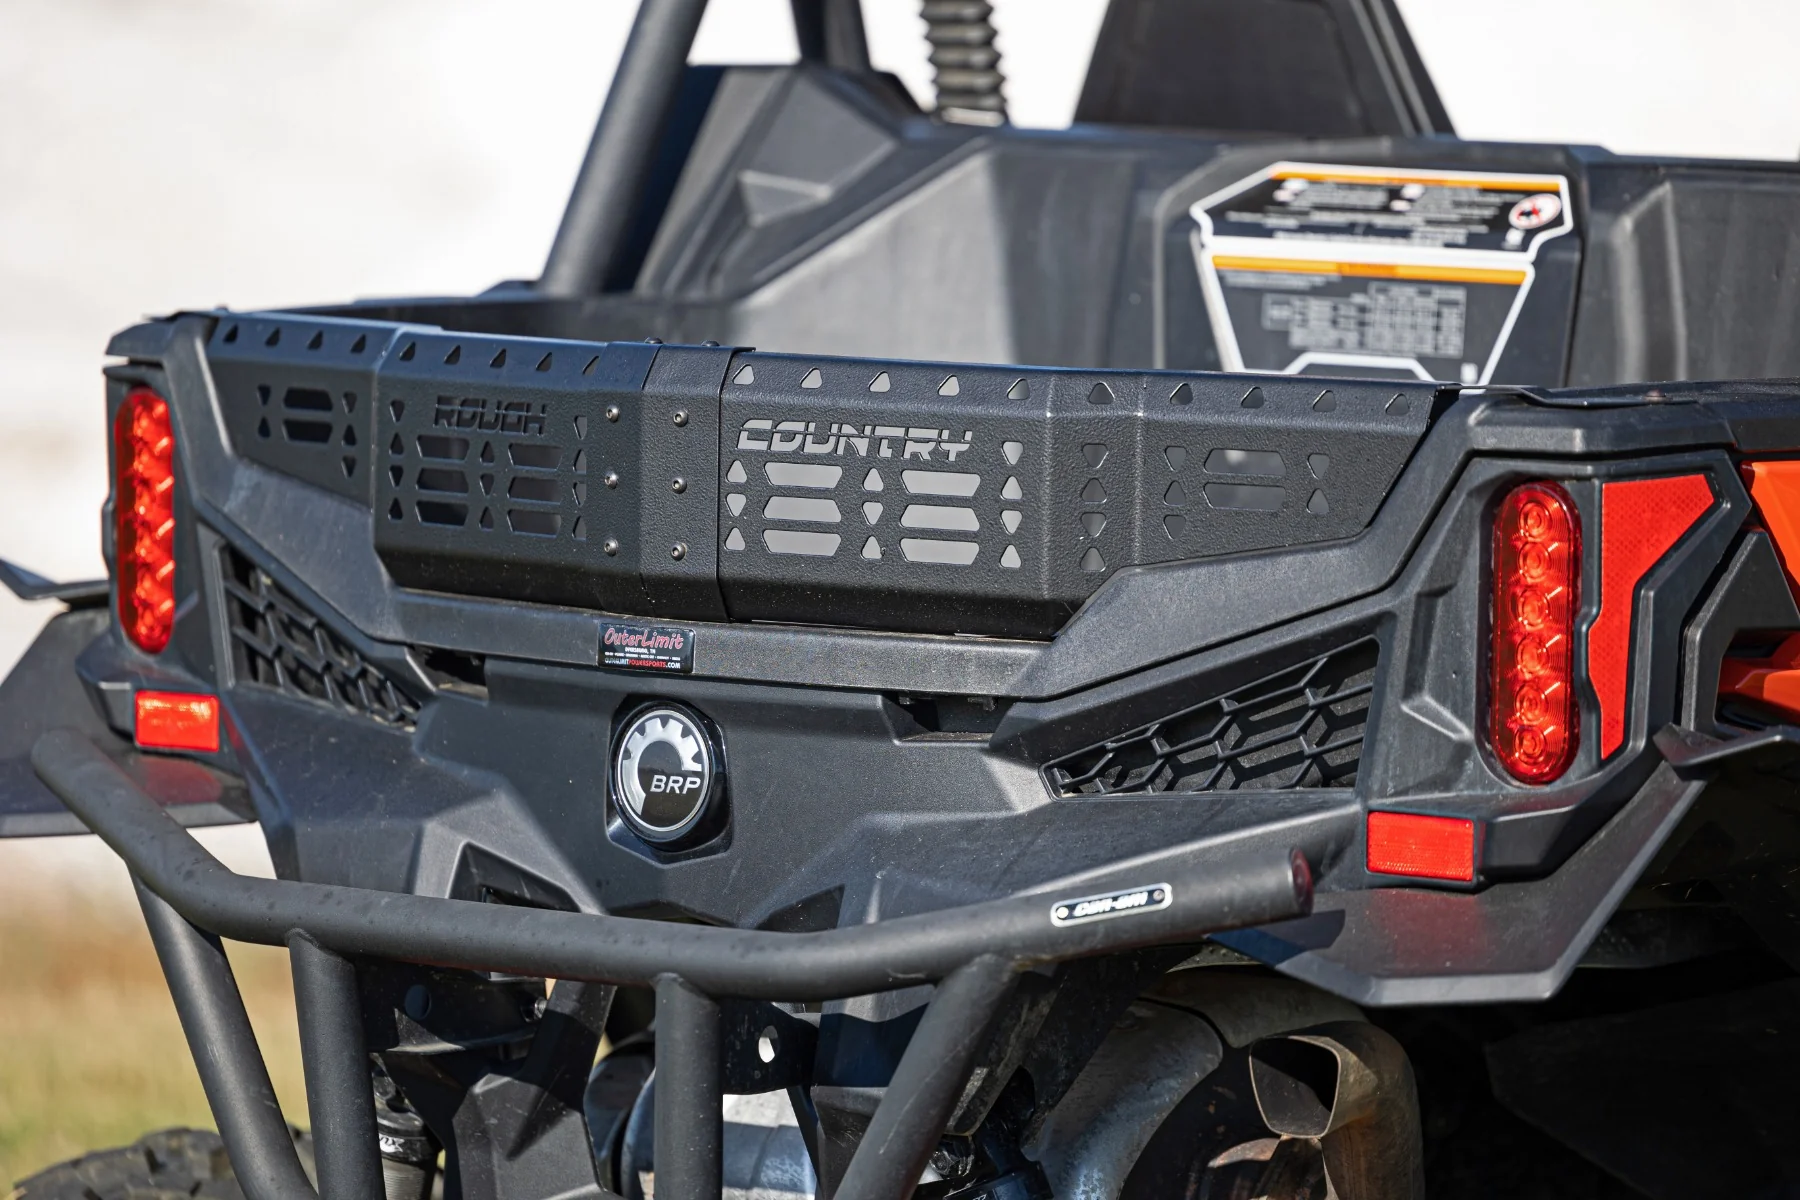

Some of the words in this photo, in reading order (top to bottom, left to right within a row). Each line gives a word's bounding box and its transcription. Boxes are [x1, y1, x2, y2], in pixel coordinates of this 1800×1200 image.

[433, 396, 547, 436] ROUGH
[736, 419, 973, 462] COUNTRY
[604, 627, 684, 649] OuterLimit
[650, 774, 701, 795] BRP
